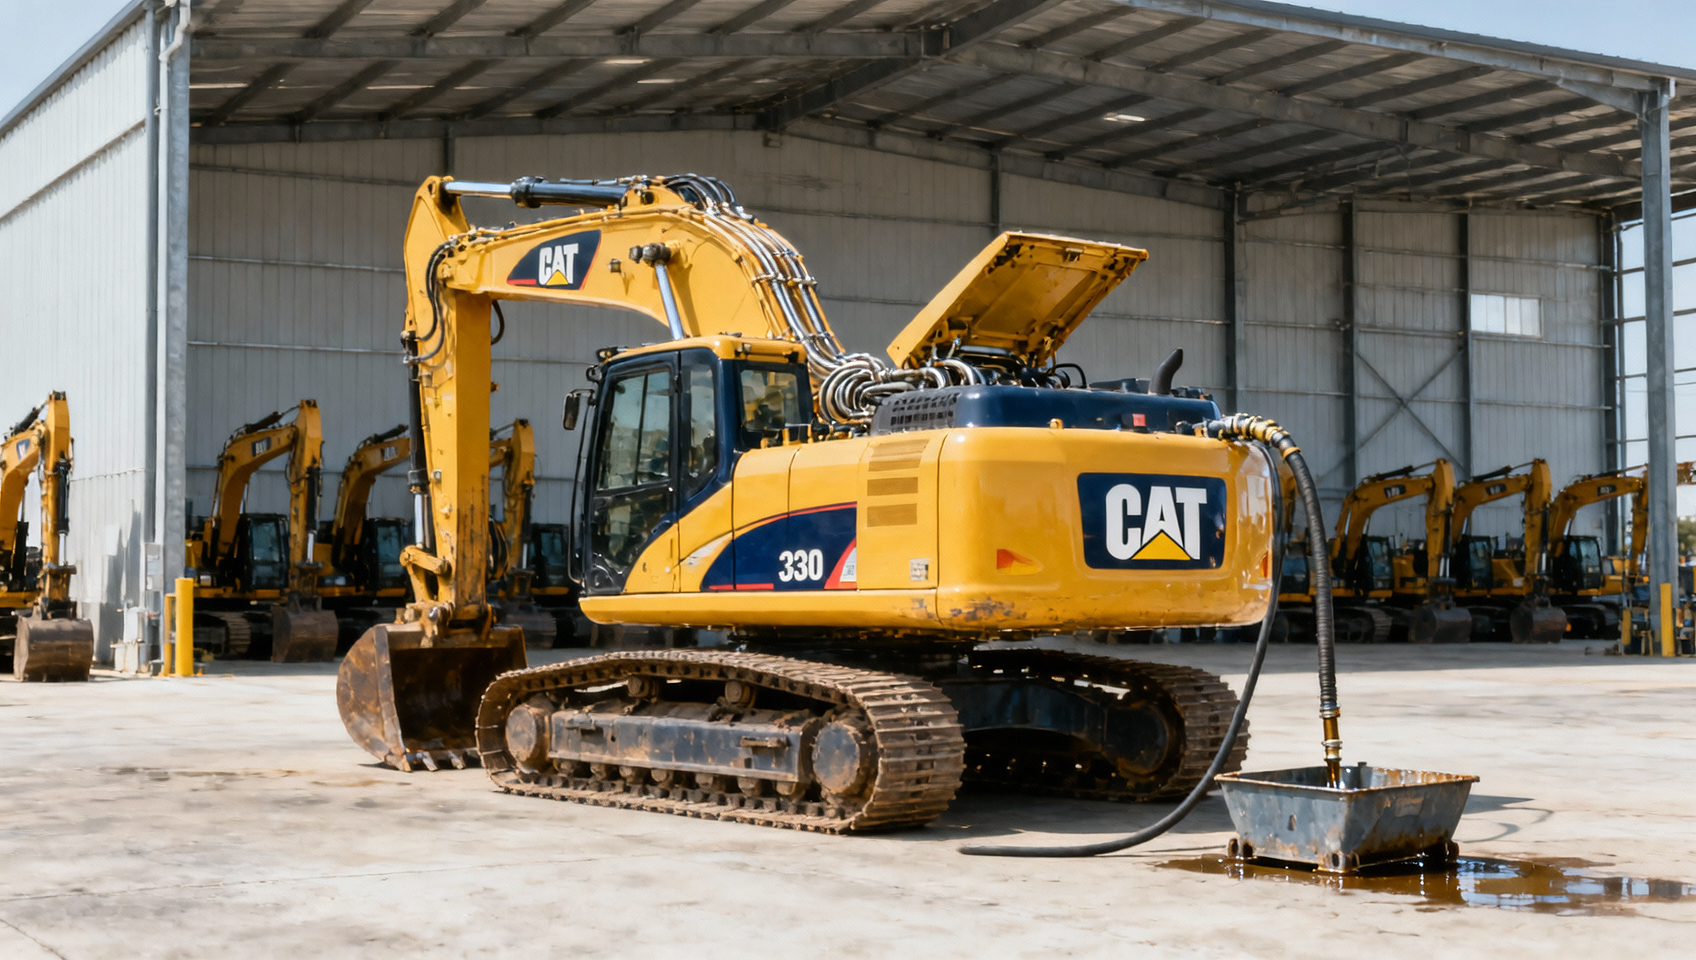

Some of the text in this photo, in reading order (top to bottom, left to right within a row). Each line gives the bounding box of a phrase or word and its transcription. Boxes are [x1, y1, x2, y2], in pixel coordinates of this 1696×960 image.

[539, 243, 579, 286] CAT
[1105, 483, 1207, 560] CAT
[778, 549, 823, 582] 330
